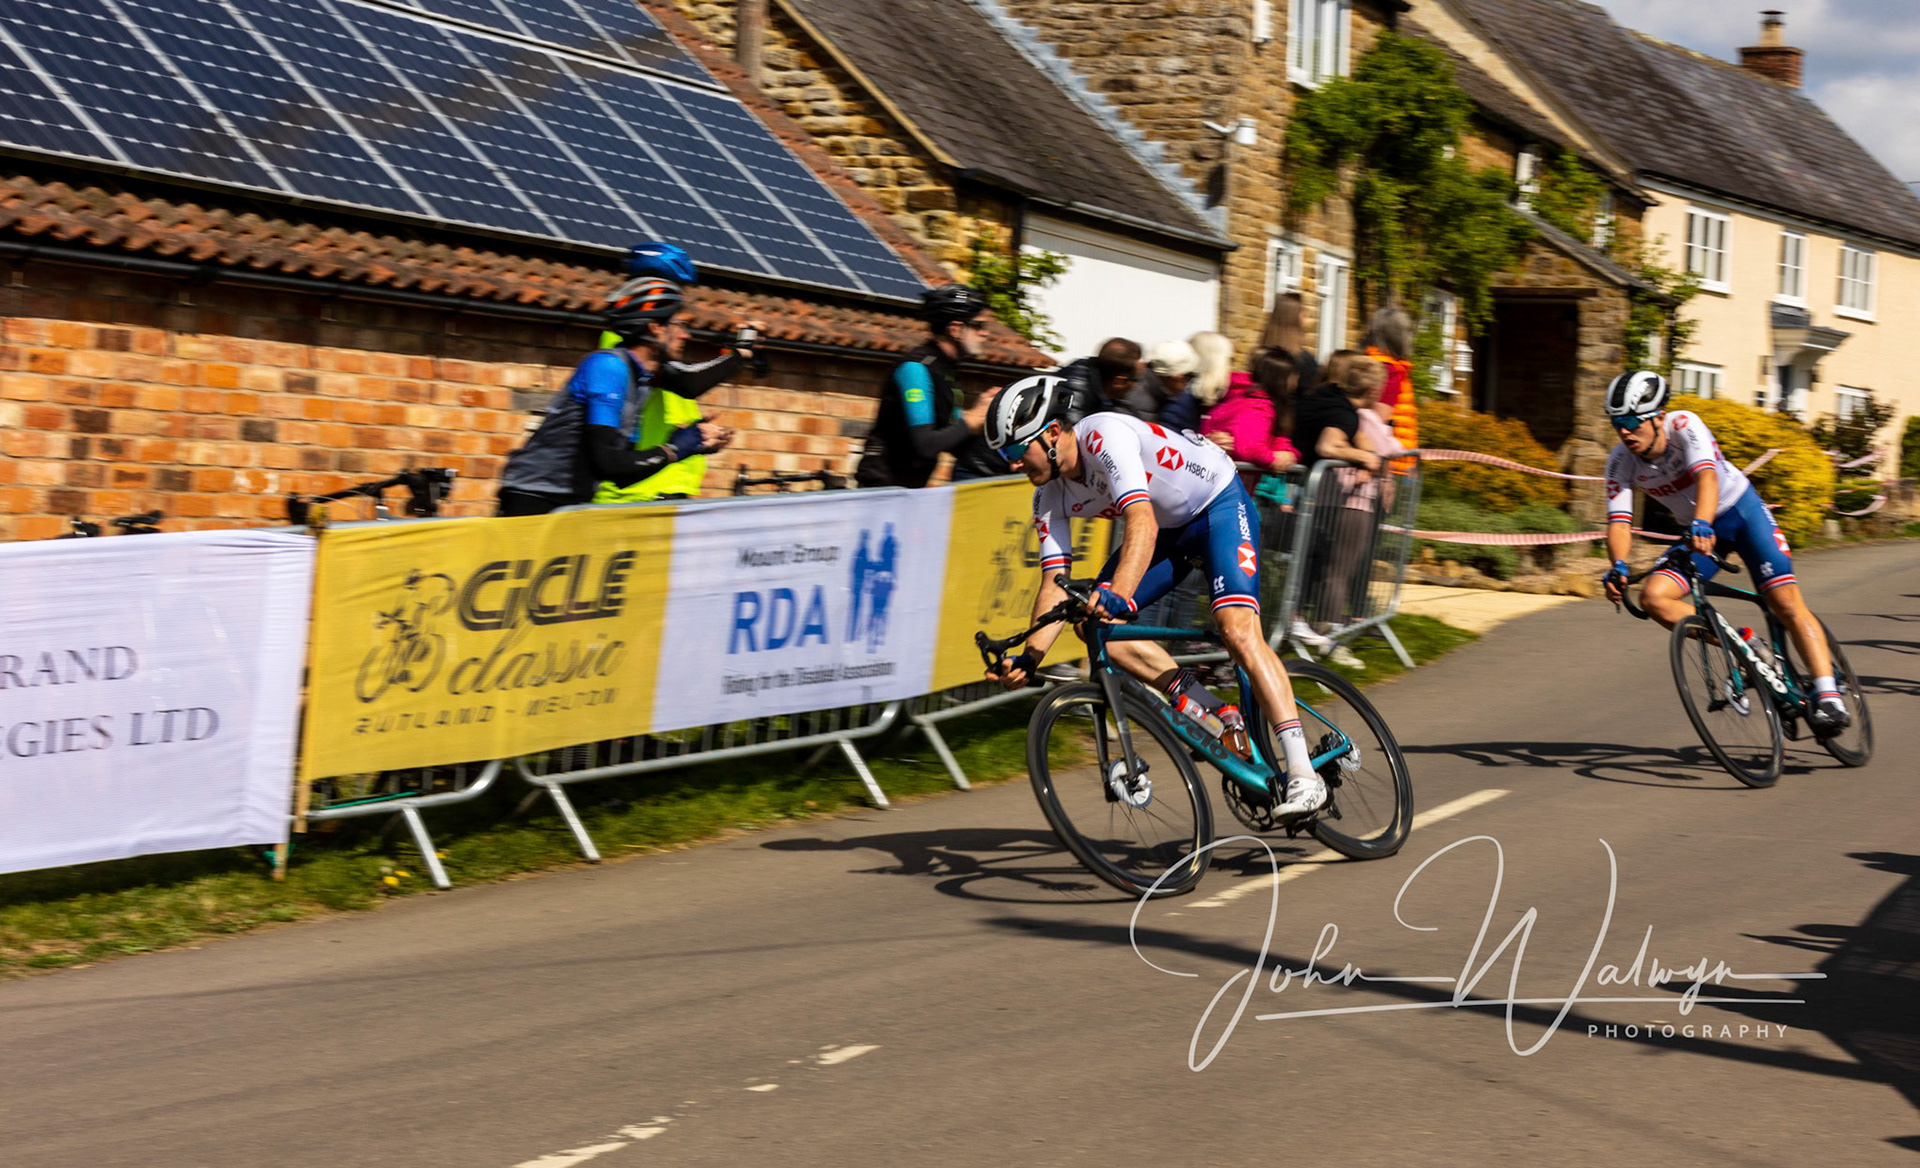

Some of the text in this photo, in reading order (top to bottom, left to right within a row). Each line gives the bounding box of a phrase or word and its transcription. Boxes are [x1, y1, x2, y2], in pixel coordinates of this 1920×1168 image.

[1099, 449, 1117, 474] HSBC
[1185, 460, 1219, 485] HSBC UK
[1238, 513, 1252, 542] HSBC
[727, 584, 831, 655] RDA
[0, 645, 140, 690] RAND
[126, 706, 220, 746] LTD
